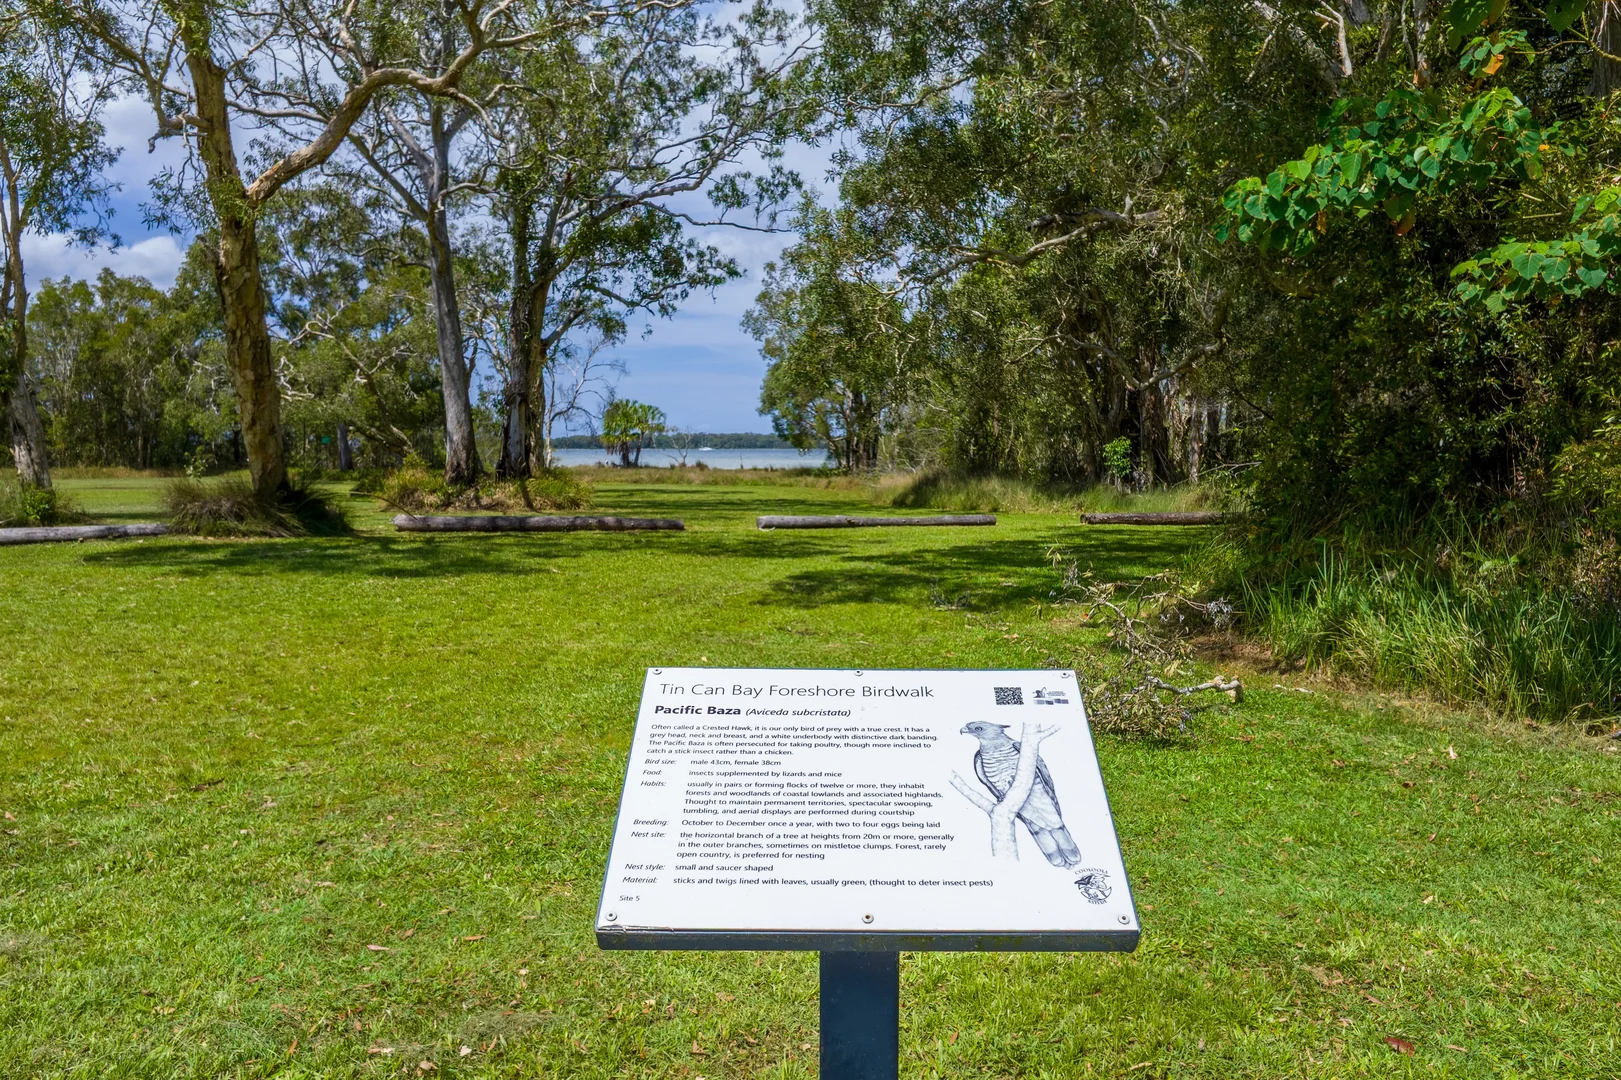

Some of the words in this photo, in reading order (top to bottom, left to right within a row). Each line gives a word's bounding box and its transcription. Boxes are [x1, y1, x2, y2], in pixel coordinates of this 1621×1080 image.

[660, 684, 684, 694] Tin
[692, 684, 725, 695] Can
[732, 685, 763, 699] Bay
[770, 685, 855, 696] Foreshore
[862, 686, 934, 697] Birdwalk
[655, 705, 702, 714] Pacific
[707, 706, 741, 715] Baza
[746, 708, 789, 716] (Aviceda
[792, 709, 851, 717] subcristata)
[918, 834, 954, 842] generally
[863, 843, 893, 851] clumps.
[782, 878, 808, 886] leaves,
[811, 879, 839, 887] usually
[869, 879, 905, 887] (thought
